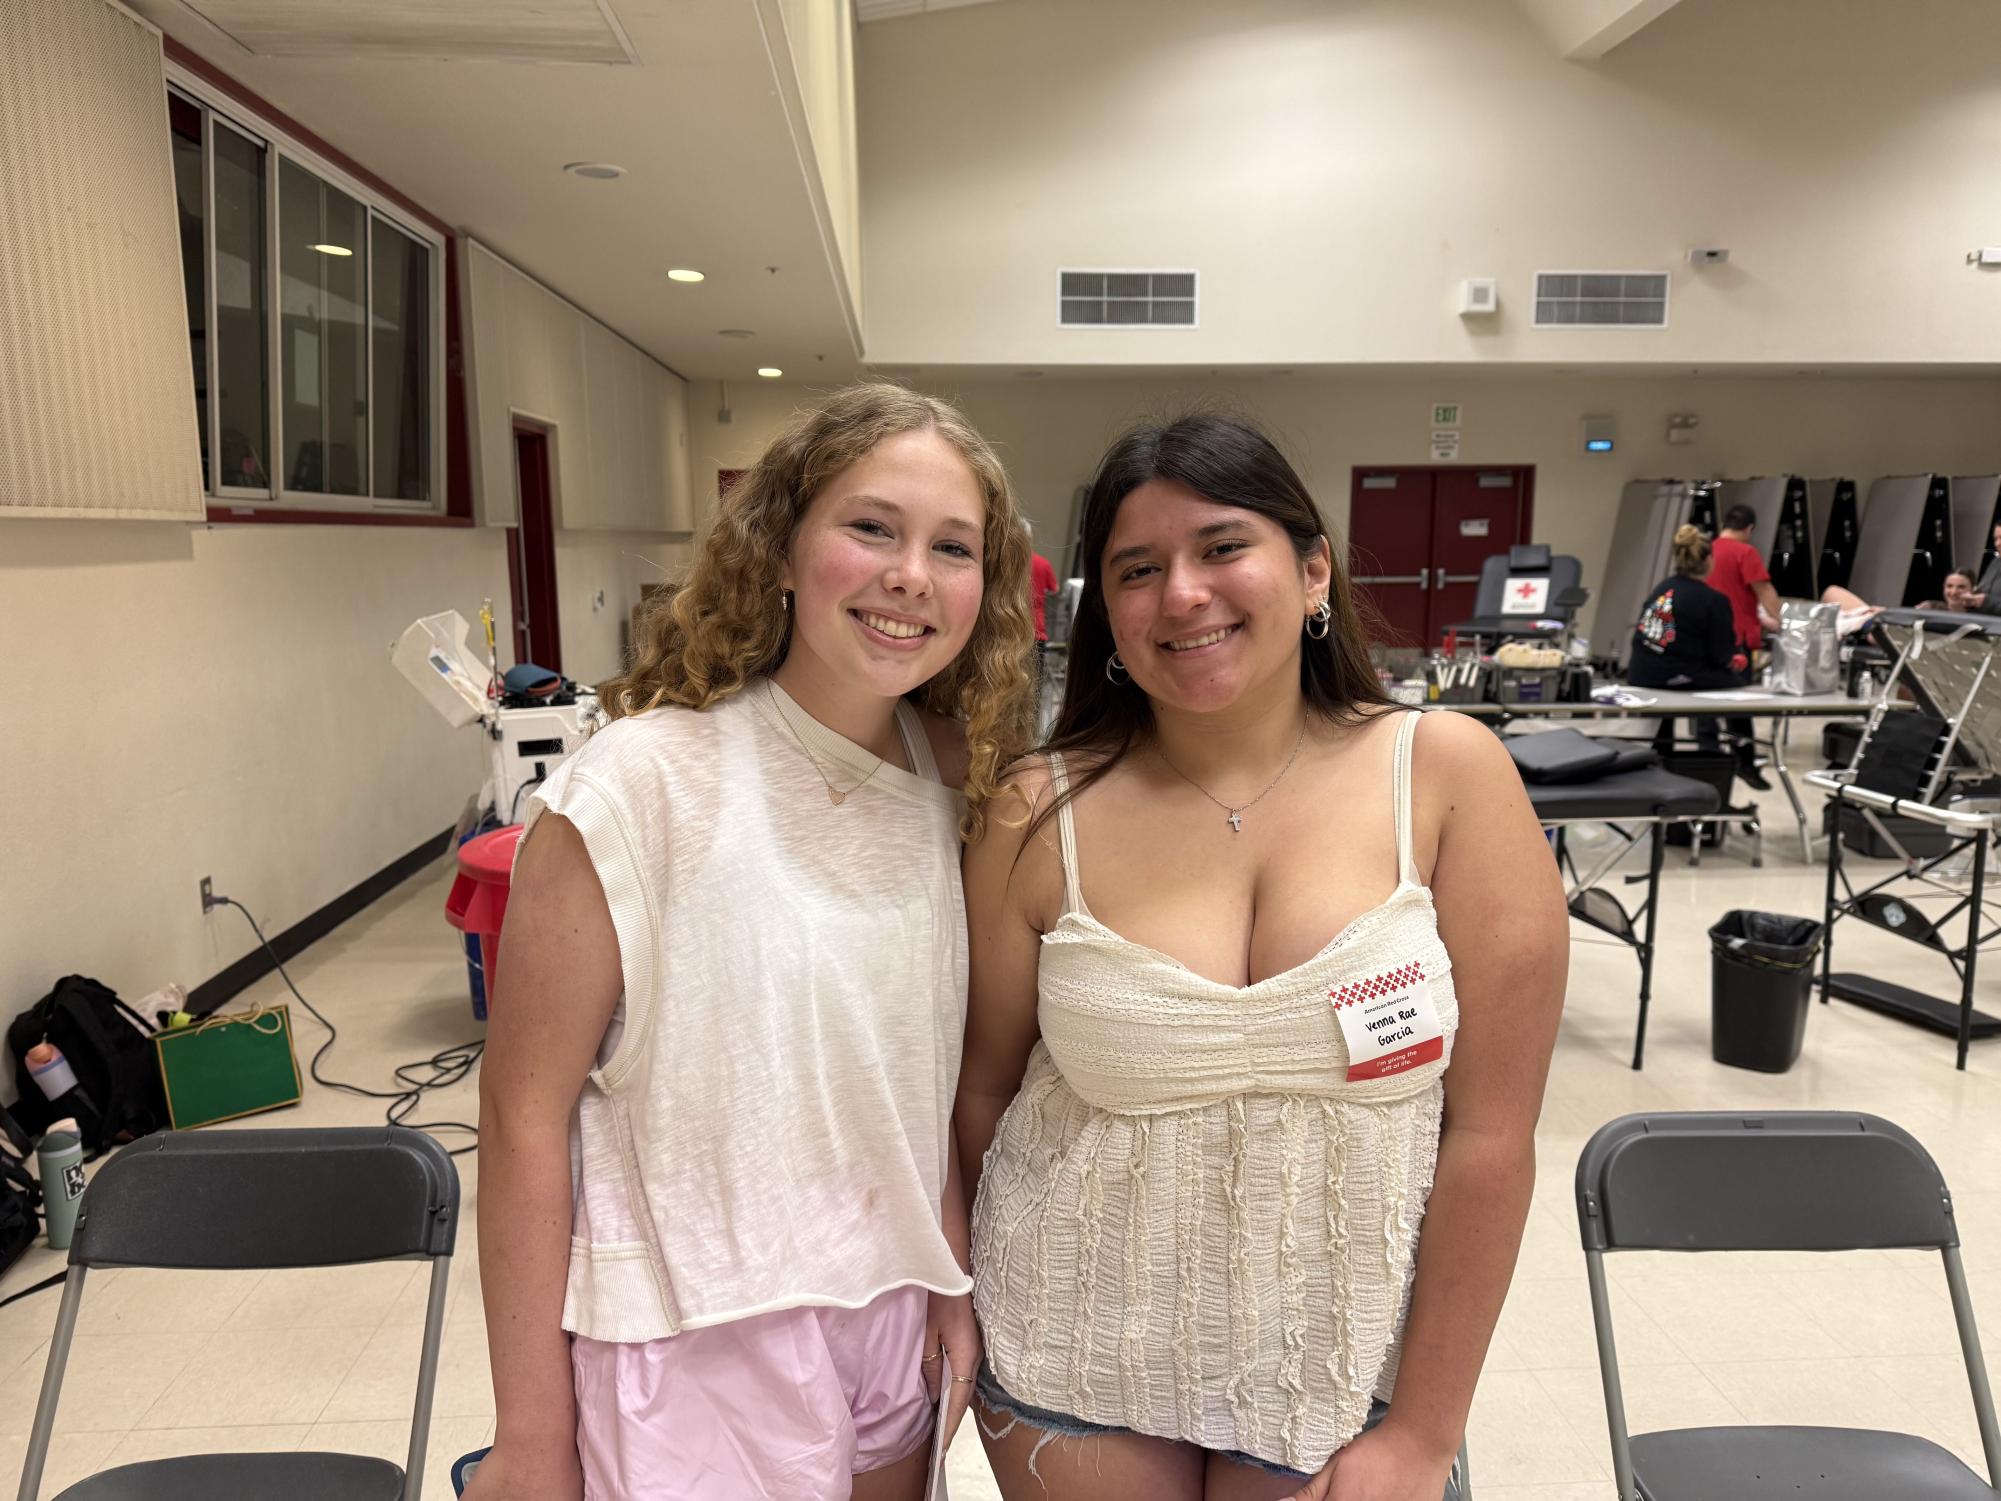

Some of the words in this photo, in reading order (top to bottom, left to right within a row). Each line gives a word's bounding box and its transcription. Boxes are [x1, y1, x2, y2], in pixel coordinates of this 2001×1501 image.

[1435, 406, 1457, 423] EXIT
[1398, 1007, 1418, 1021] Rae
[1377, 1026, 1414, 1046] Garcia
[1387, 1054, 1405, 1064] giving
